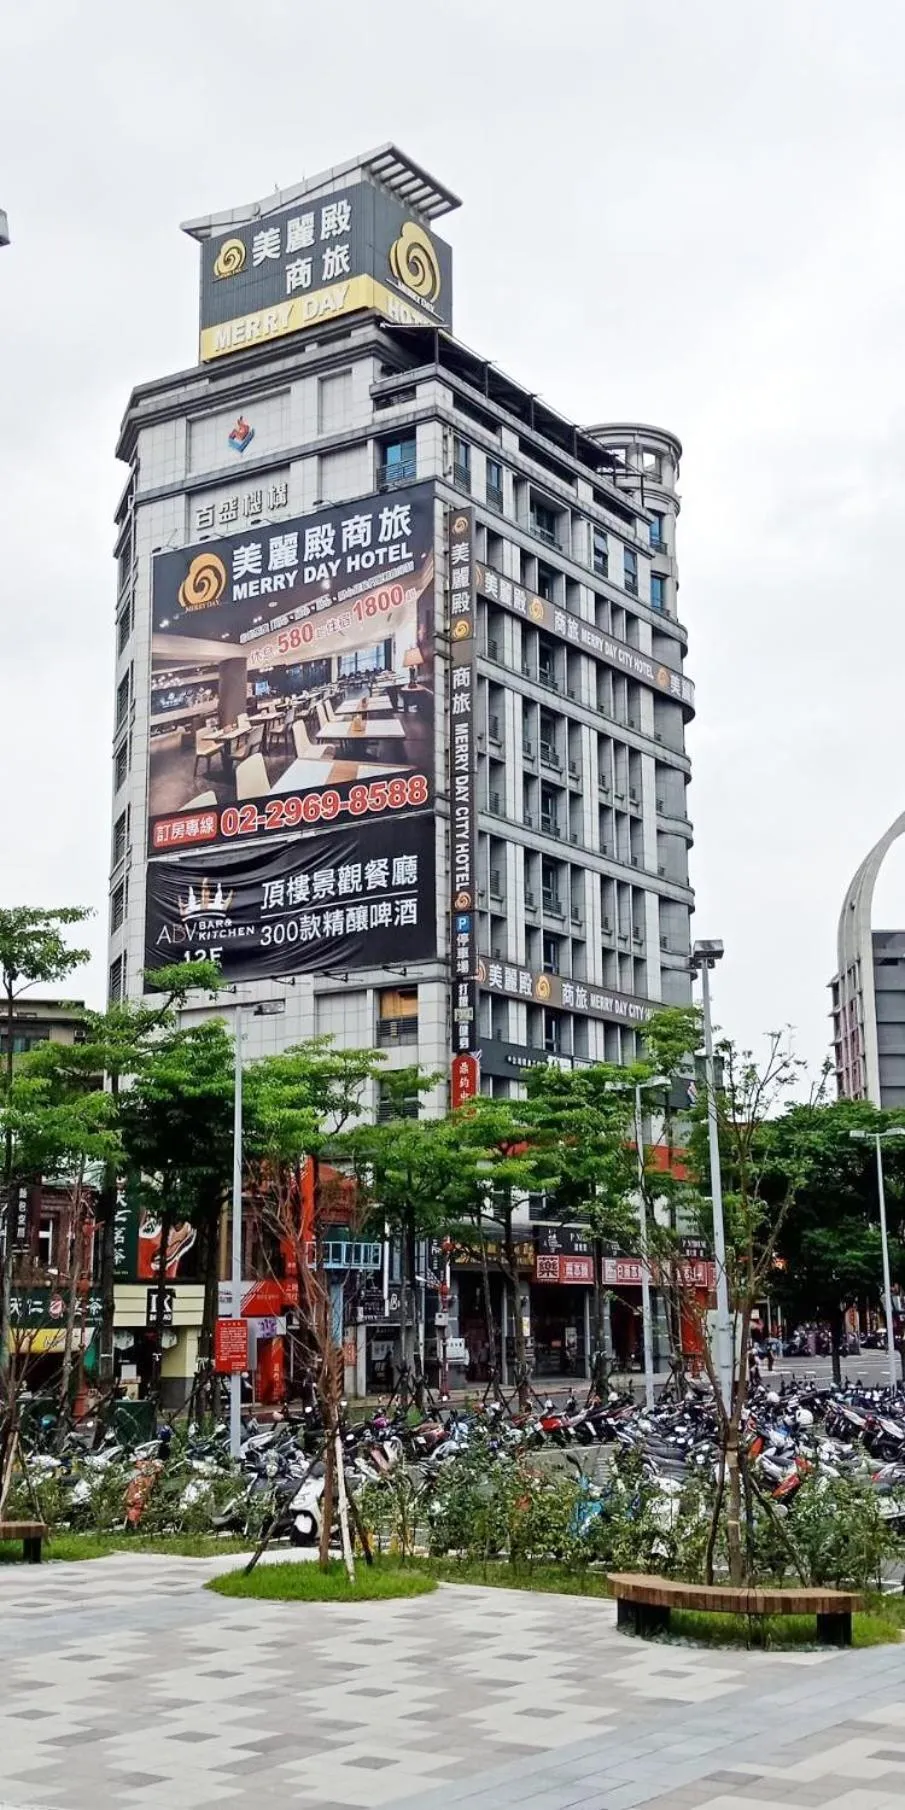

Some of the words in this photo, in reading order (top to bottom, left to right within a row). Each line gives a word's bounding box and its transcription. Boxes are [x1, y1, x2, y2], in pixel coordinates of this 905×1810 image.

[252, 199, 352, 267] 美麗殿
[285, 244, 351, 294] 商旅
[214, 304, 294, 352] MERRY
[303, 283, 350, 322] DAY
[232, 503, 413, 580] 美麗殿商旅
[233, 570, 298, 601] MERRY
[303, 558, 342, 584] DAY
[346, 541, 414, 573] HOTEL
[451, 542, 471, 615] 美麗殿
[277, 622, 314, 655] 580
[353, 583, 406, 622] 1800
[484, 571, 527, 614] 美麗殿
[554, 610, 579, 643] 商旅
[581, 628, 605, 652] MERRY
[605, 641, 618, 658] DAY
[618, 651, 634, 668] CITY
[634, 657, 654, 680] HOTEL
[452, 666, 471, 715] 商旅
[455, 722, 469, 775] MERRY
[155, 815, 215, 843] 訂房專線
[220, 775, 428, 838] 02-2969-8588
[455, 775, 469, 803] DAY
[455, 806, 470, 841] CITY
[260, 854, 418, 911] 頂樓景觀餐廳
[455, 843, 470, 892] HOTEL
[198, 919, 232, 931] BAR&
[198, 925, 255, 941] KITCHEN
[260, 898, 418, 947] 300款精釀啤酒
[458, 917, 467, 931] P
[489, 964, 533, 996] 美麗殿
[562, 982, 588, 1010] 商旅
[590, 993, 613, 1013] MERRY
[614, 1000, 628, 1017] DAY
[628, 1003, 644, 1021] CITY
